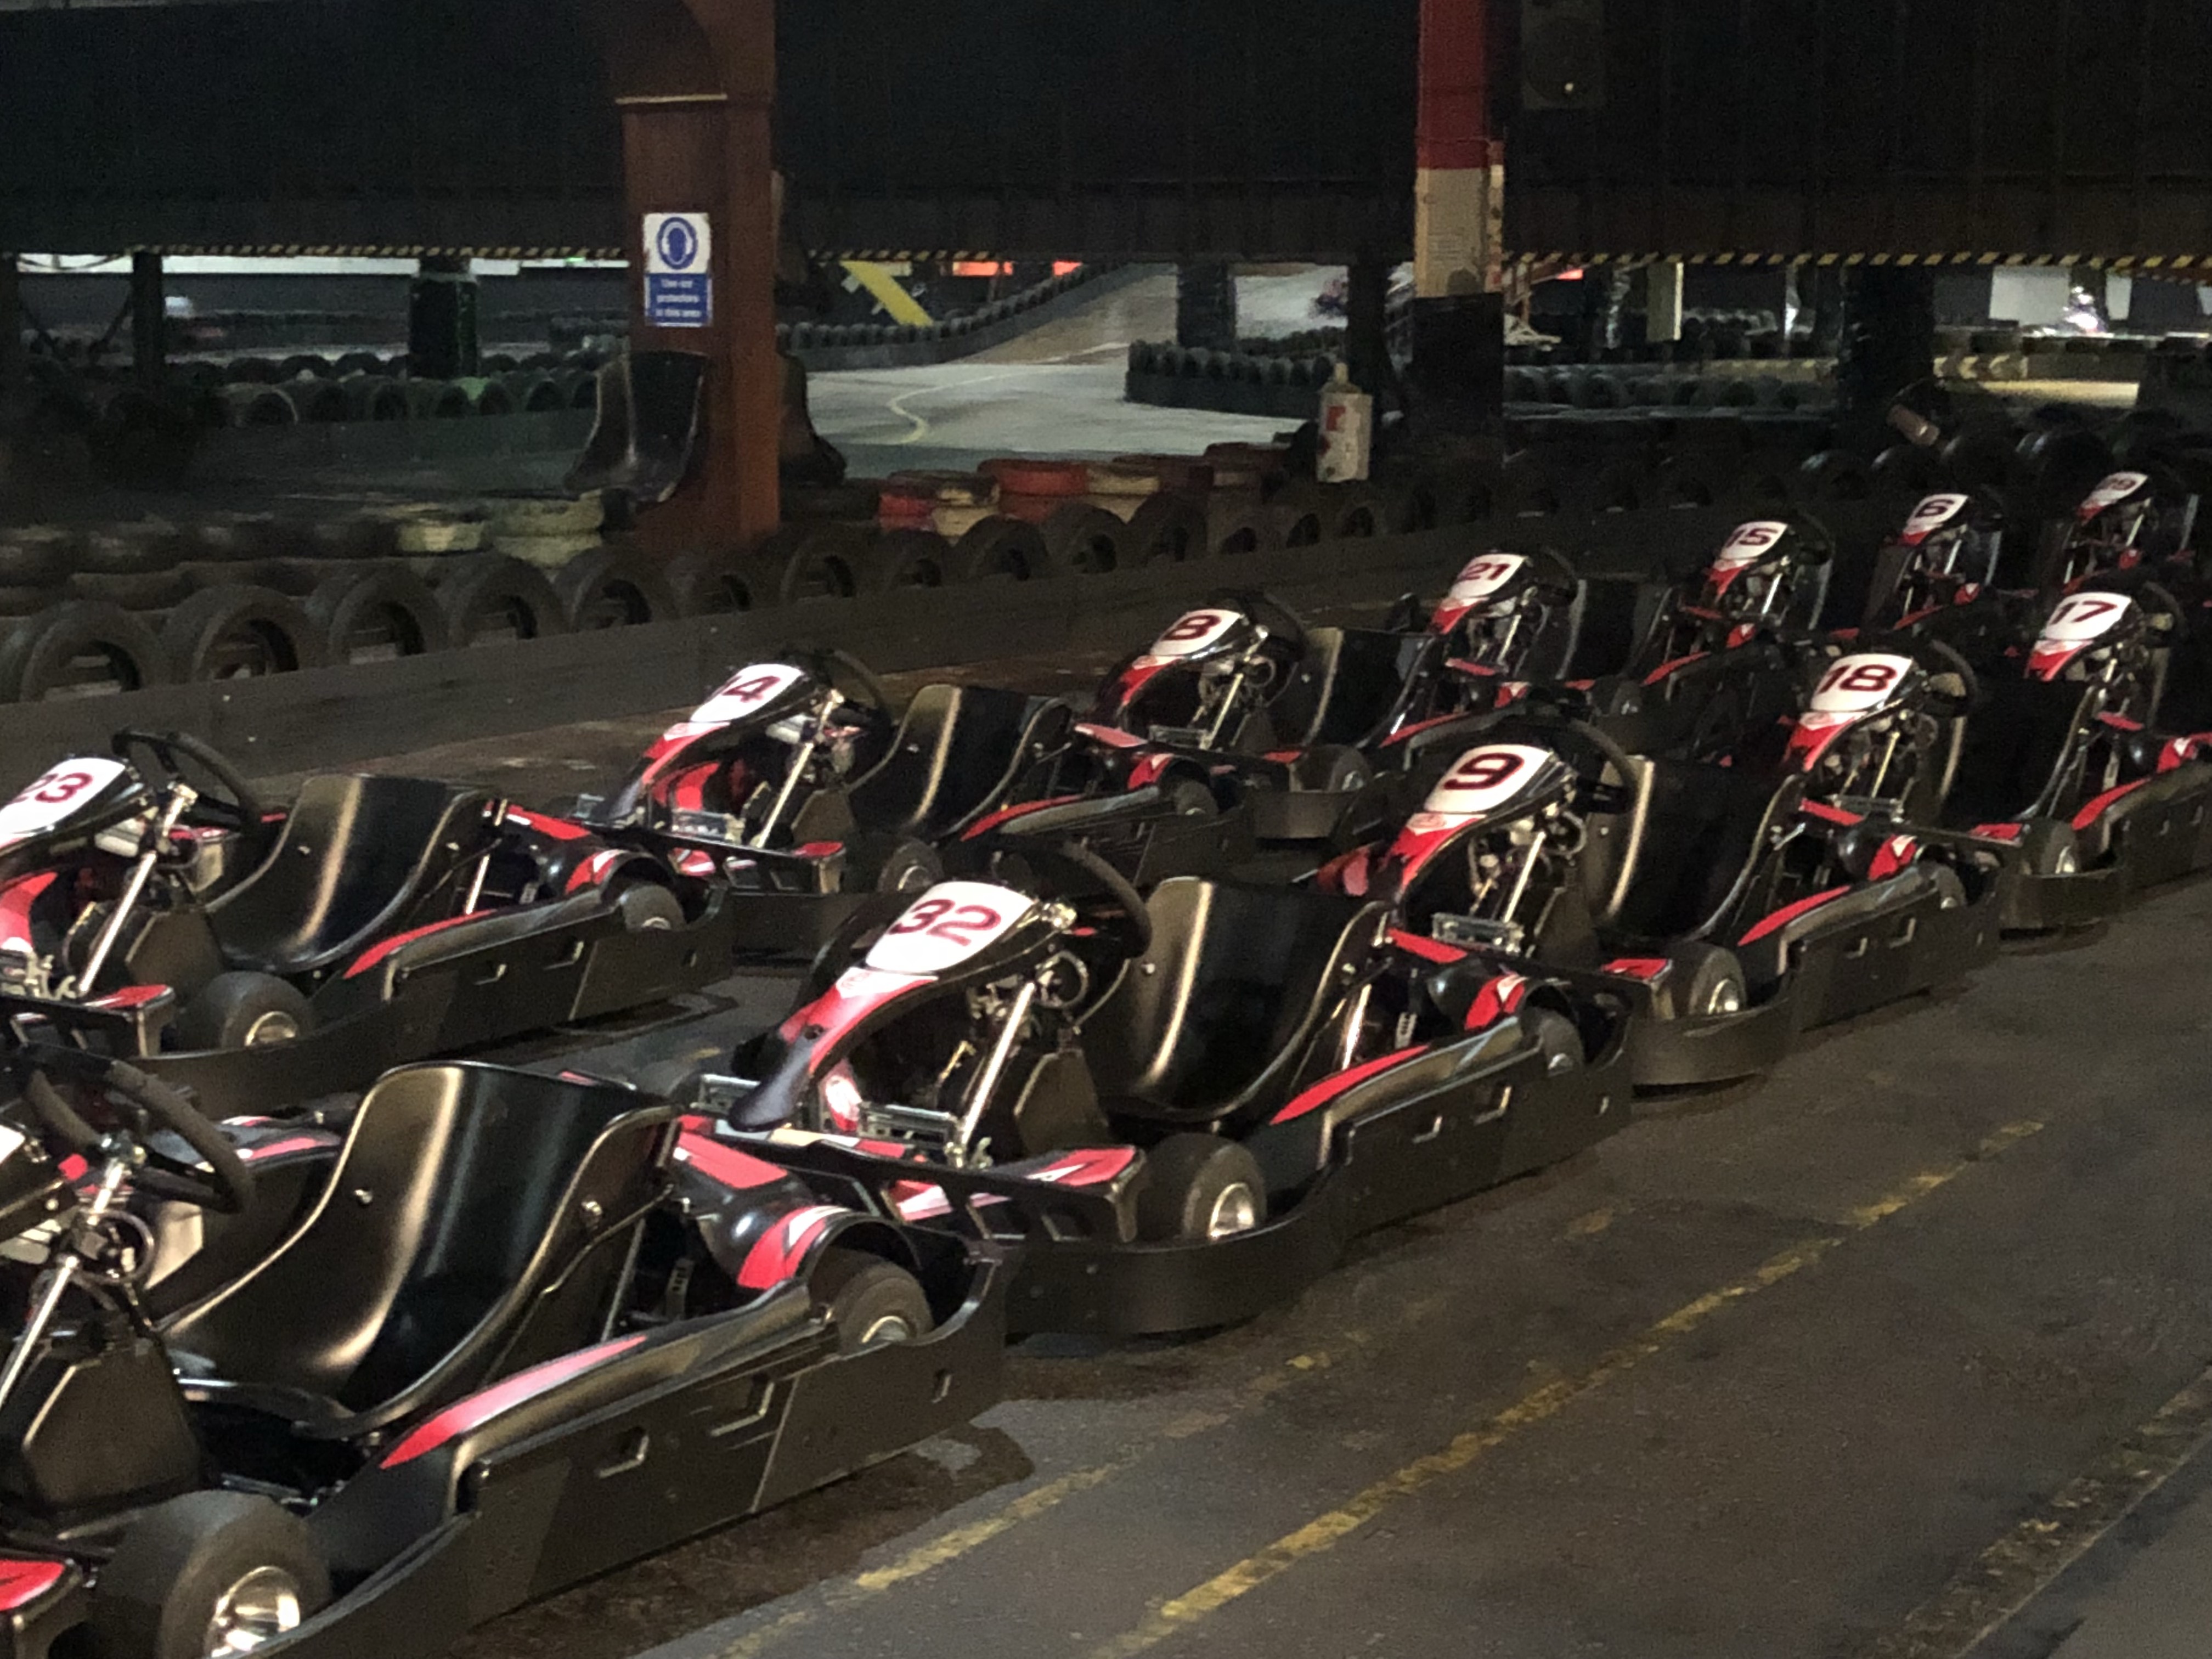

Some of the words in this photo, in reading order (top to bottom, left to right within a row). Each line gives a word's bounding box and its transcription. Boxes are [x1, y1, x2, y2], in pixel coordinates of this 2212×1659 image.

[1915, 499, 1956, 517] 6
[1728, 527, 1779, 546] 15
[1458, 562, 1512, 581] 21
[2050, 600, 2118, 625] 17
[1158, 614, 1222, 642] 8
[1817, 664, 1898, 694] 18
[1443, 752, 1525, 790] 9
[888, 899, 1002, 947] 32
